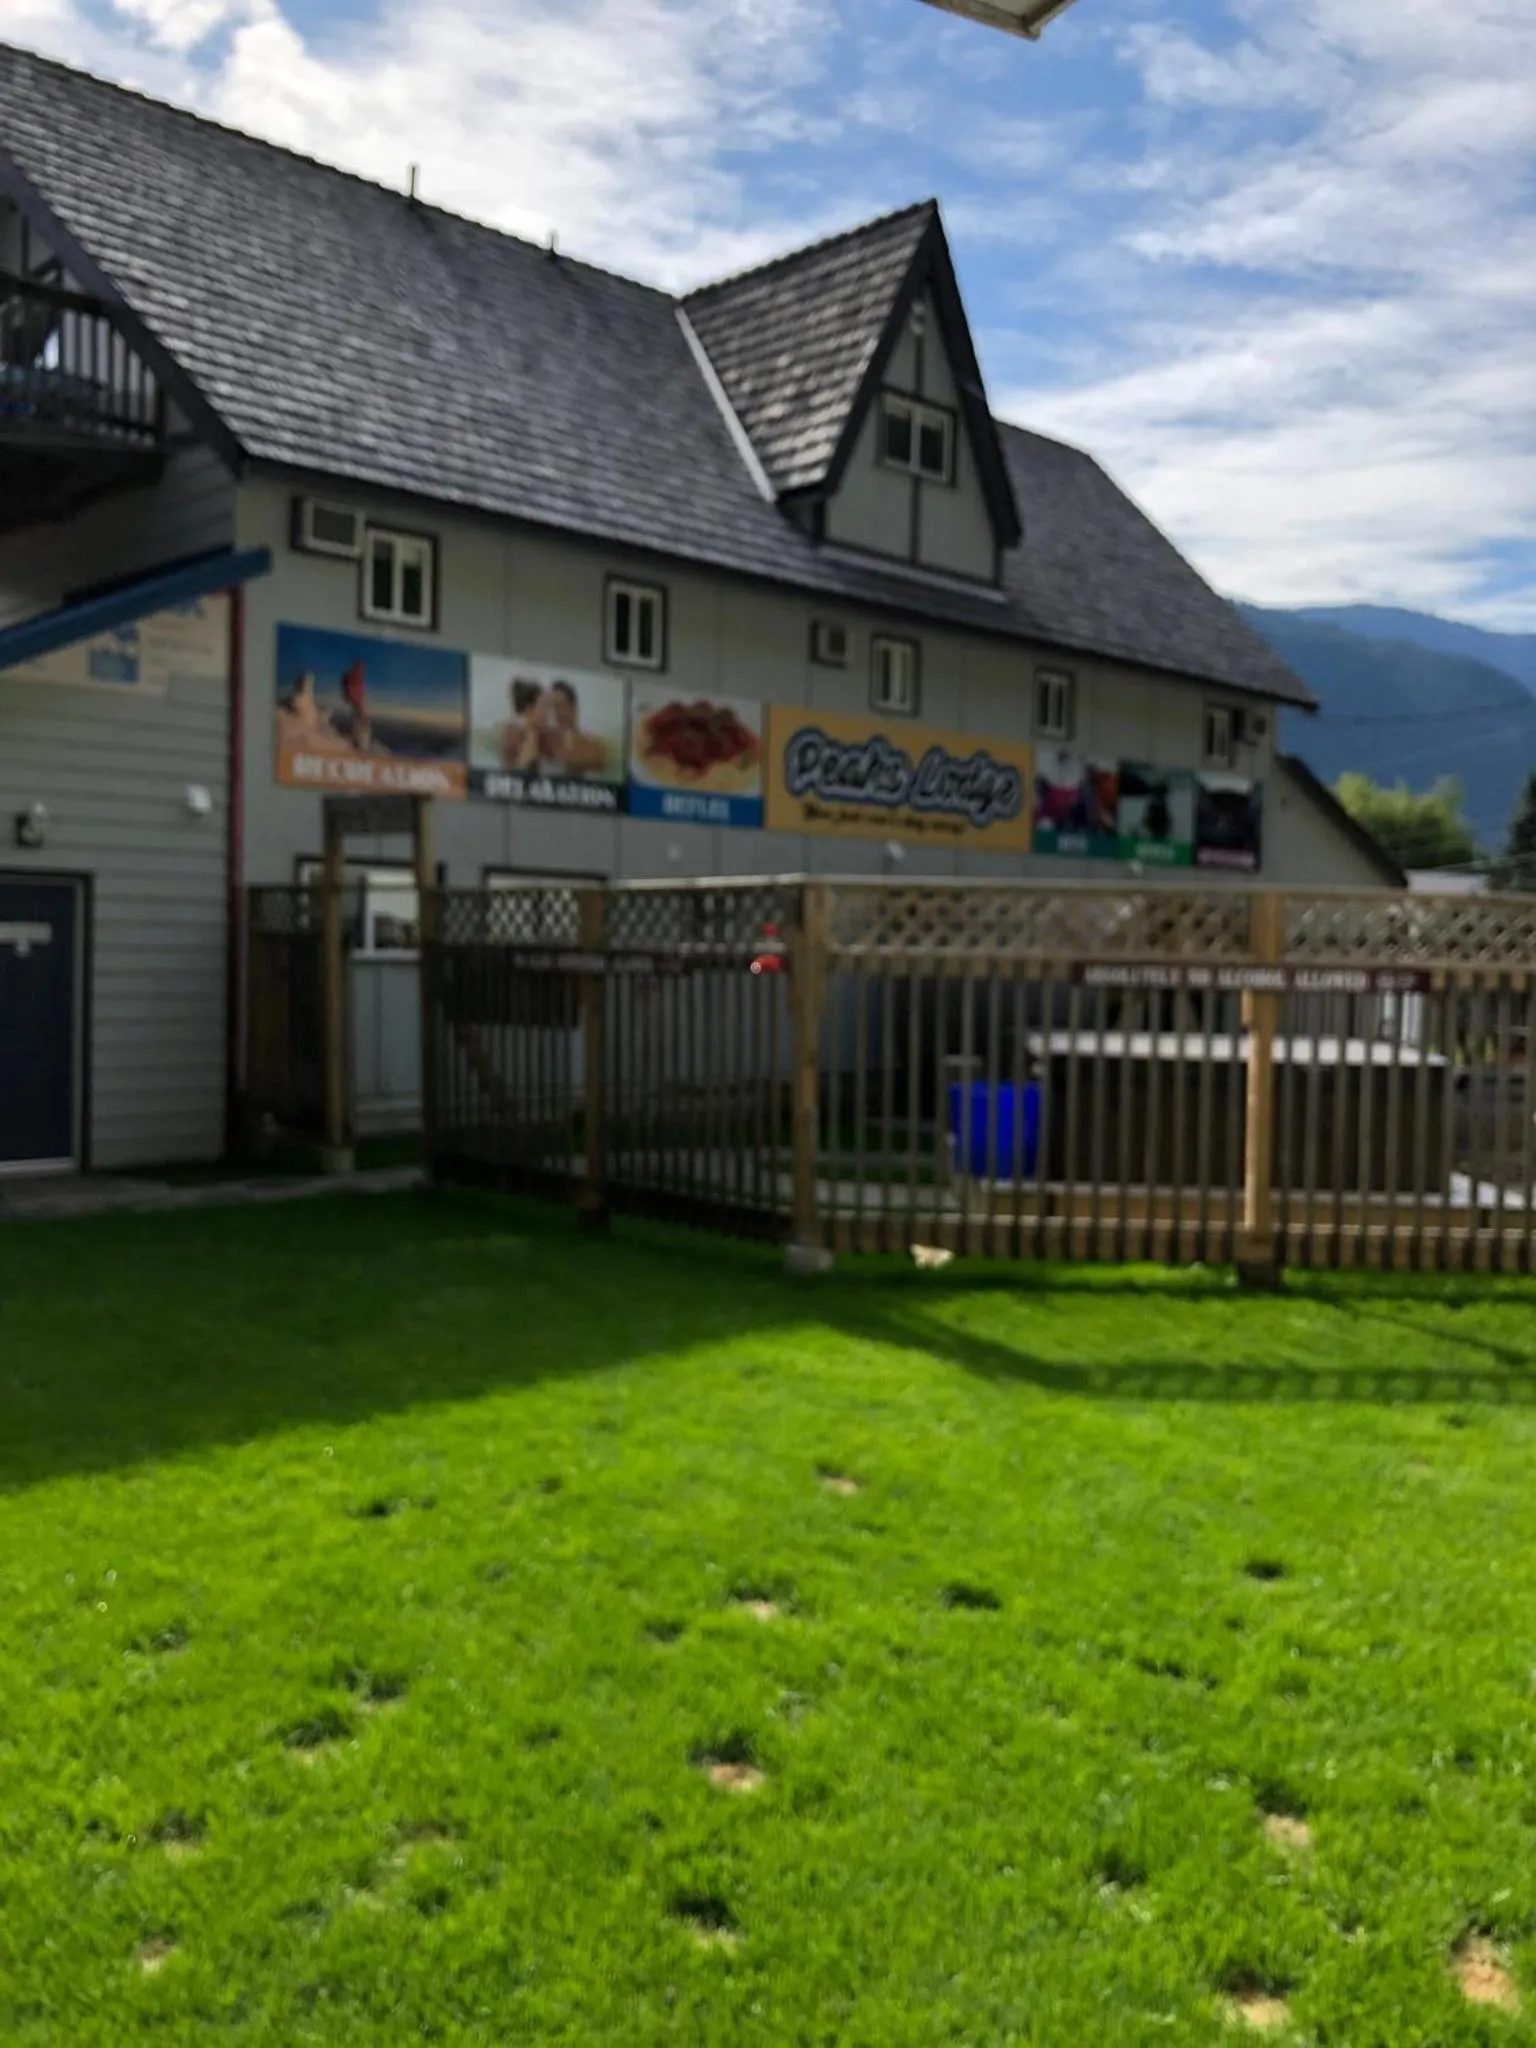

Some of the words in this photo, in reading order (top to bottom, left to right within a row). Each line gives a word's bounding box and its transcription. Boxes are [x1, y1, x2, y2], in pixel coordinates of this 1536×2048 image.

[1188, 967, 1210, 986] NO
[1217, 968, 1286, 988] ALCOHOL
[1294, 970, 1367, 988] ALLOWED
